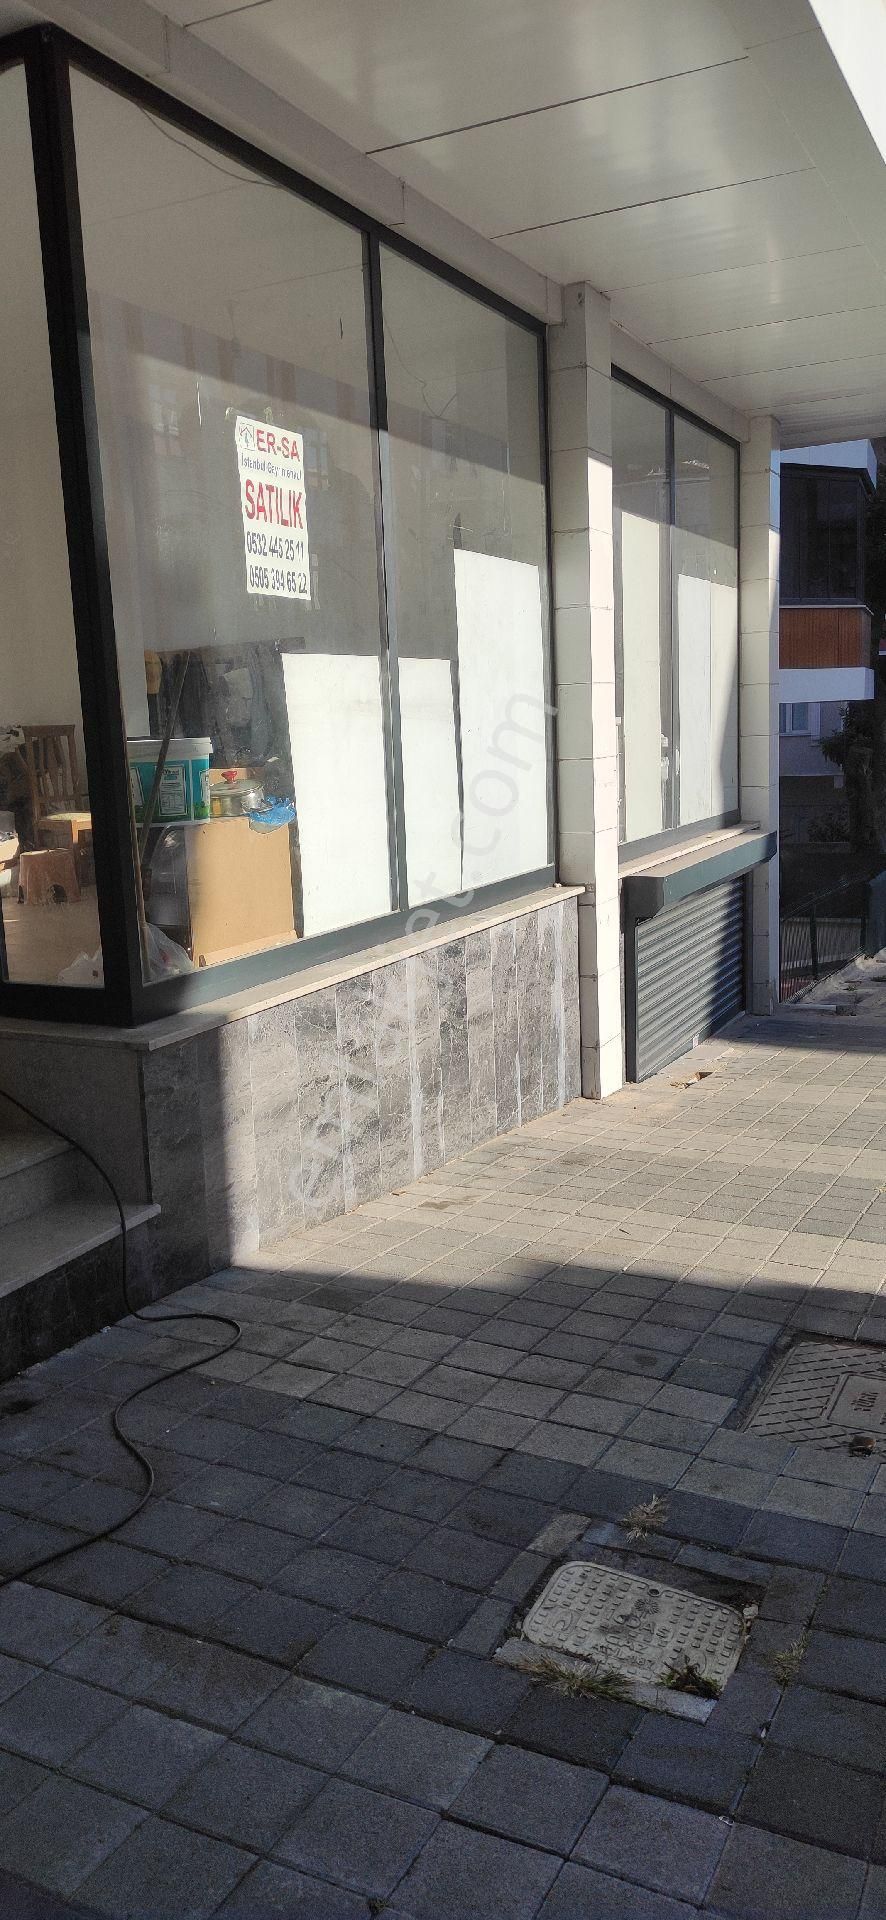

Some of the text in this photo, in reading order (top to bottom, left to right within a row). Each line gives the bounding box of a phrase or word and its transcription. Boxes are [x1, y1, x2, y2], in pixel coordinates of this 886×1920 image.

[255, 429, 301, 462] ER-SA
[244, 478, 304, 530] SATILIK
[246, 530, 268, 557] 0532
[284, 538, 295, 561] 25
[295, 540, 304, 562] 11
[249, 564, 270, 590] 0505
[286, 571, 297, 593] 65
